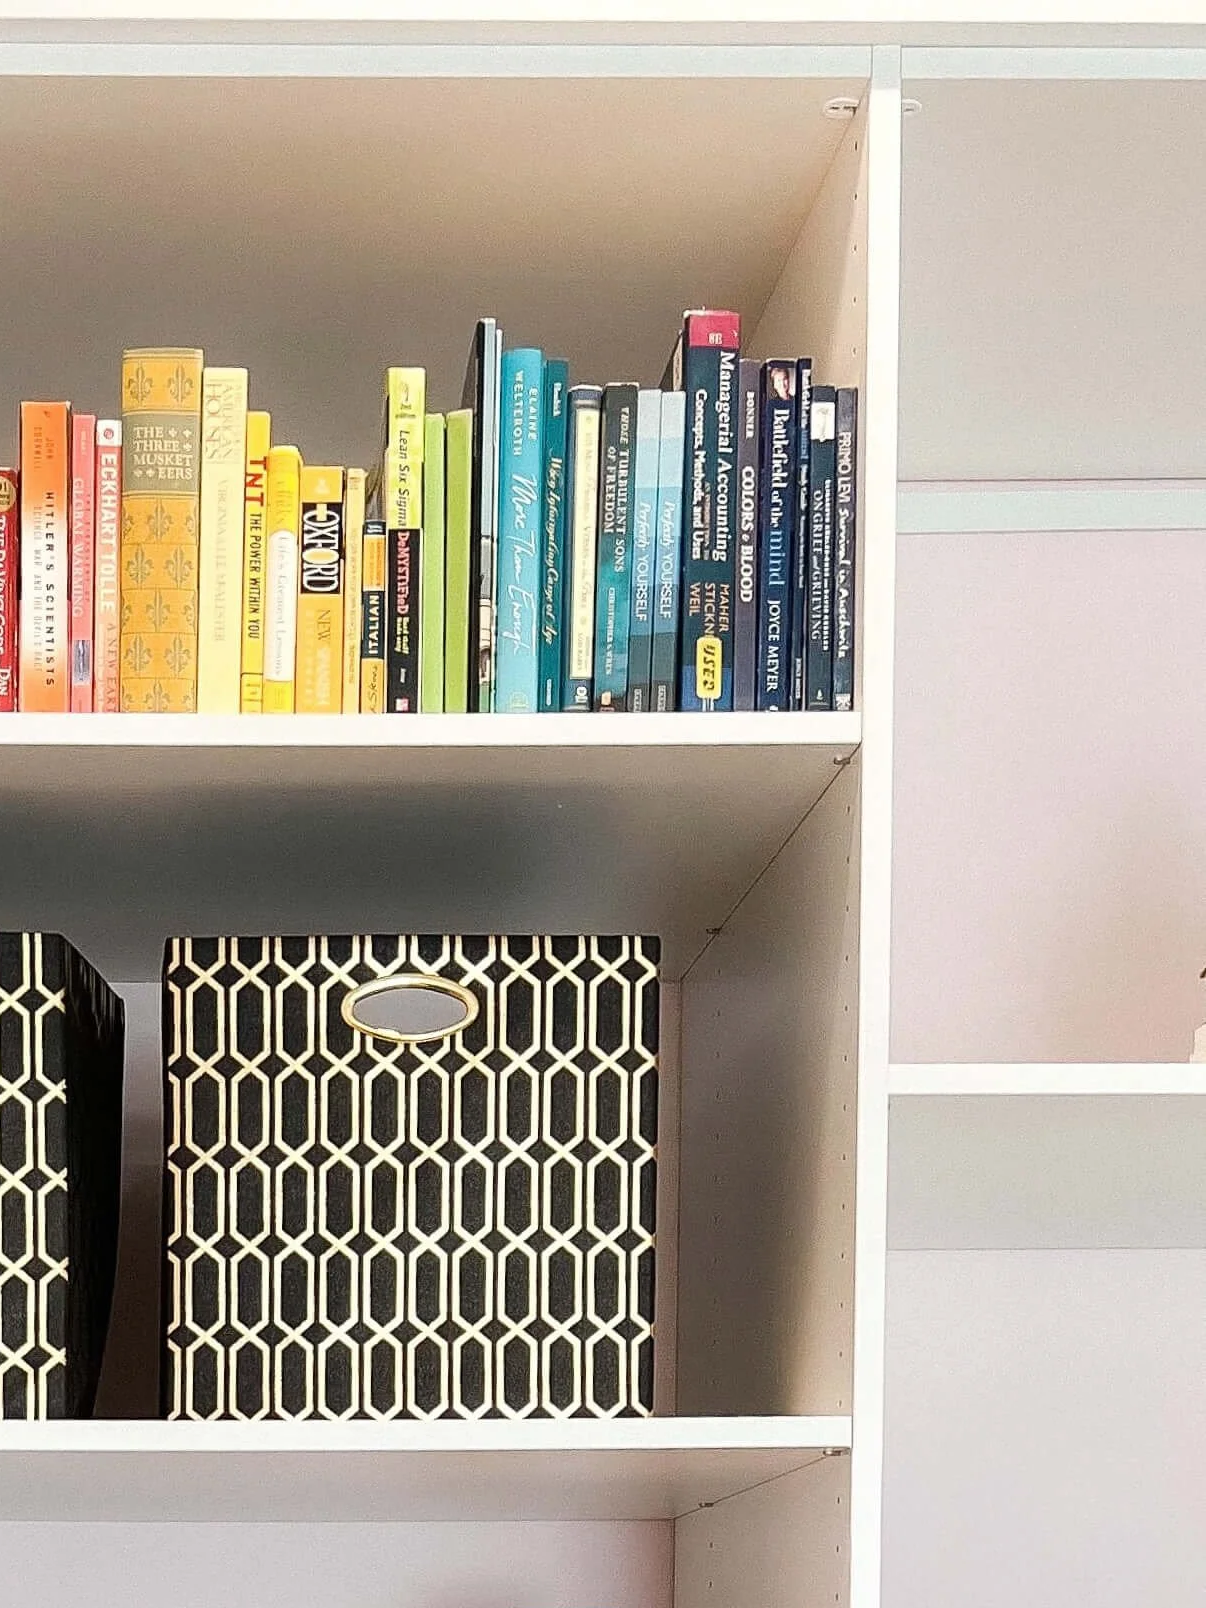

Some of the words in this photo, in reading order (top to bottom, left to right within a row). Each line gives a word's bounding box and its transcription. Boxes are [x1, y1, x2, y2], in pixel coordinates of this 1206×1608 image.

[205, 383, 222, 460] HOUSES
[221, 384, 233, 459] AMERICAN
[513, 369, 524, 456] WELTEROTH
[529, 386, 539, 441] ELAINE
[619, 407, 630, 445] THOSE
[693, 389, 708, 449] Concepts,
[714, 351, 736, 453] Managerial
[745, 391, 755, 439] BONNER
[133, 426, 163, 439] THE
[133, 439, 180, 451] THREE
[399, 430, 410, 459] Lean
[772, 408, 790, 488] Battlefield
[837, 431, 851, 474] PRIMO
[132, 453, 193, 467] MUSKET
[158, 467, 193, 480] EERS
[245, 456, 268, 507] TNT
[399, 464, 410, 483] Six
[692, 450, 706, 505] Methods,
[73, 478, 84, 538] GLOBAL
[100, 453, 117, 546] ECKHART
[396, 487, 410, 527] Sigma
[511, 474, 538, 529] More
[604, 465, 616, 533] FREEDOM
[615, 449, 630, 534] TURBULENT
[712, 458, 732, 562] Accounting
[741, 466, 755, 531] COLORS
[771, 490, 782, 506] of
[813, 489, 823, 513] ON
[837, 476, 851, 503] LEVI
[45, 492, 55, 571] HITLER'S
[250, 513, 262, 531] THE
[635, 502, 652, 549] Perfectly
[661, 500, 676, 548] Perfectly
[692, 506, 705, 528] and
[769, 508, 783, 528] the
[812, 514, 823, 554] GRIEF
[837, 507, 850, 565] Survival
[249, 535, 261, 573] POWER
[302, 510, 341, 592] OXFORD
[505, 530, 536, 584] Than
[613, 538, 626, 573] SONS
[691, 530, 705, 560] Uses
[768, 530, 786, 585] mind
[72, 540, 84, 617] WARMING
[99, 553, 116, 614] TOLLE
[249, 577, 261, 614] WITHIN
[636, 556, 649, 622] YOURSELF
[660, 553, 674, 618] YOURSELF
[740, 545, 754, 602] BLOOD
[838, 569, 849, 584] in
[501, 584, 537, 656] Enough
[689, 582, 701, 617] WEIL
[719, 583, 730, 632] MAHER
[767, 600, 781, 642] JOYCE
[811, 571, 822, 640] GRIEVING
[837, 588, 850, 659] Auschwitz
[45, 584, 55, 686] SCIENTISTS
[248, 619, 260, 640] YOU
[317, 609, 331, 641] NEW
[369, 594, 382, 656] ITALIAN
[107, 637, 117, 668] NEW
[703, 643, 716, 692] USED
[766, 645, 779, 692] MEYER
